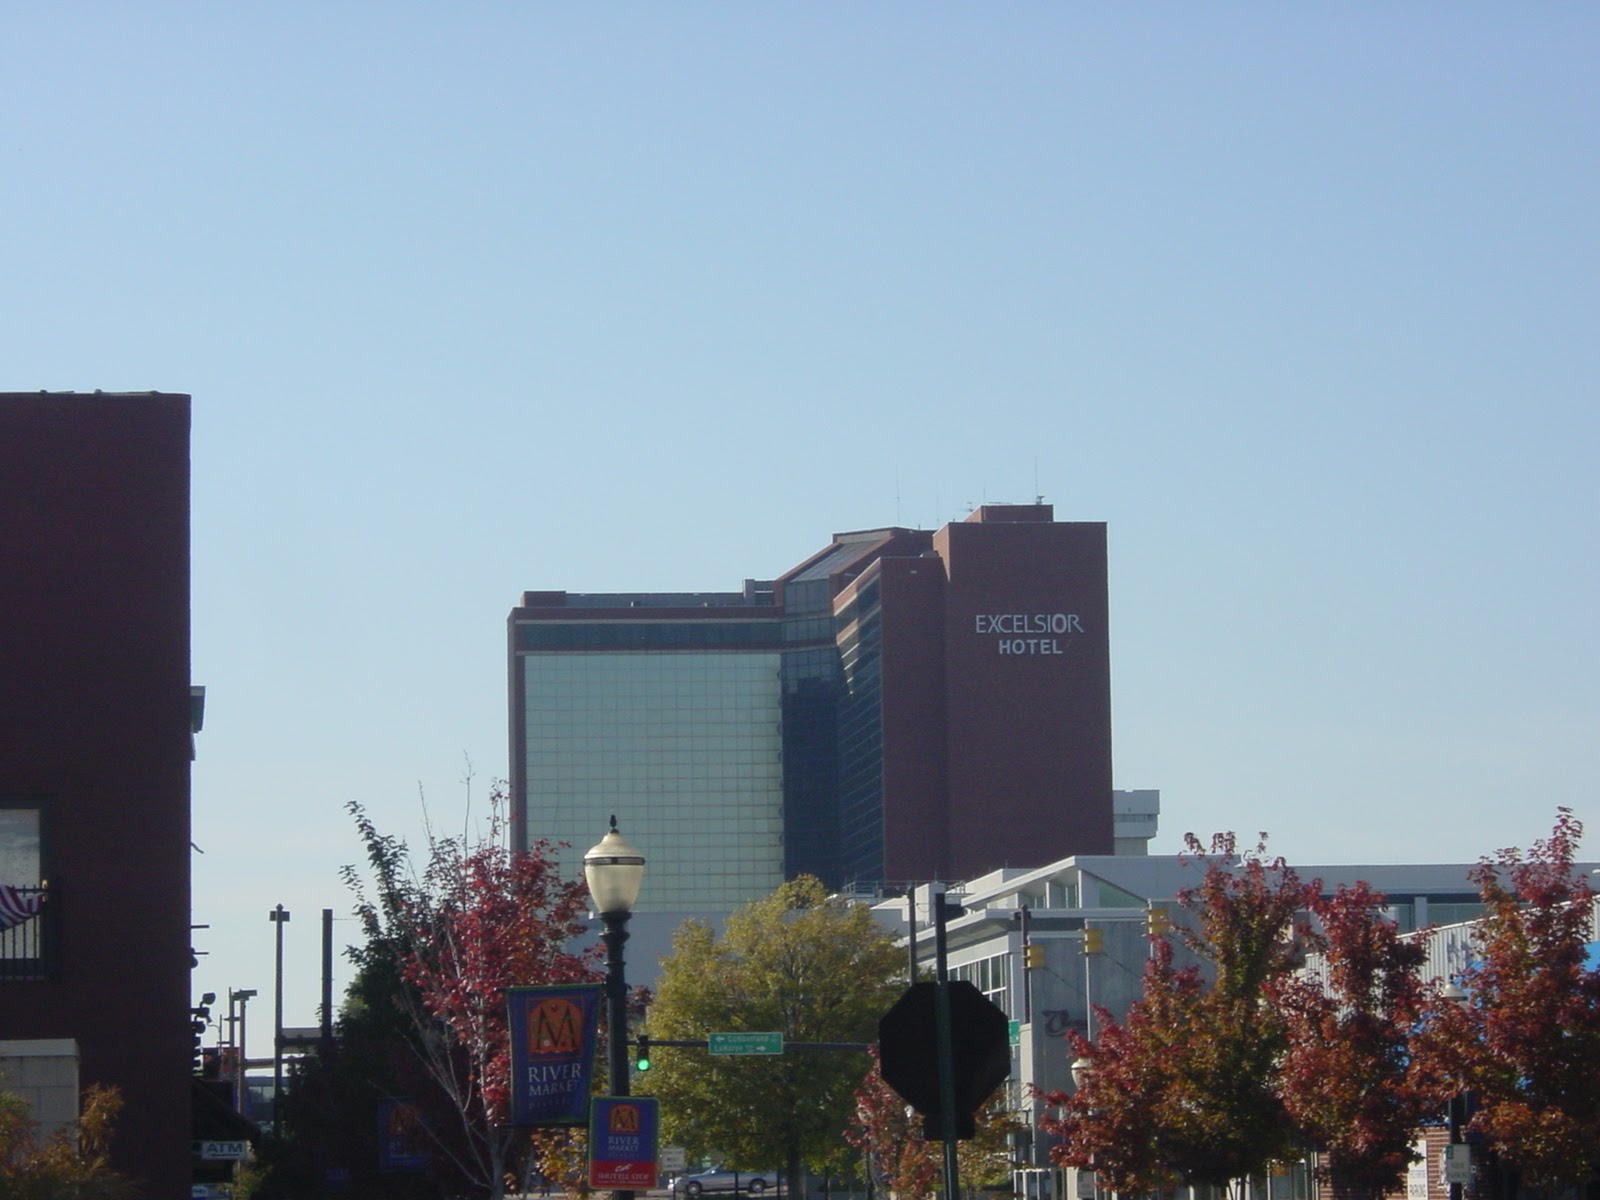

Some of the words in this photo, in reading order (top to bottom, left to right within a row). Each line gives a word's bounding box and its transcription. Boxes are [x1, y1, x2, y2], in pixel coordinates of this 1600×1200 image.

[975, 613, 1084, 634] EXCELSIOR
[998, 639, 1063, 655] HOTEL
[527, 1062, 582, 1083] RIVER
[528, 1076, 579, 1097] MARKET
[207, 1143, 243, 1153] ATM
[607, 1136, 640, 1145] RIVER
